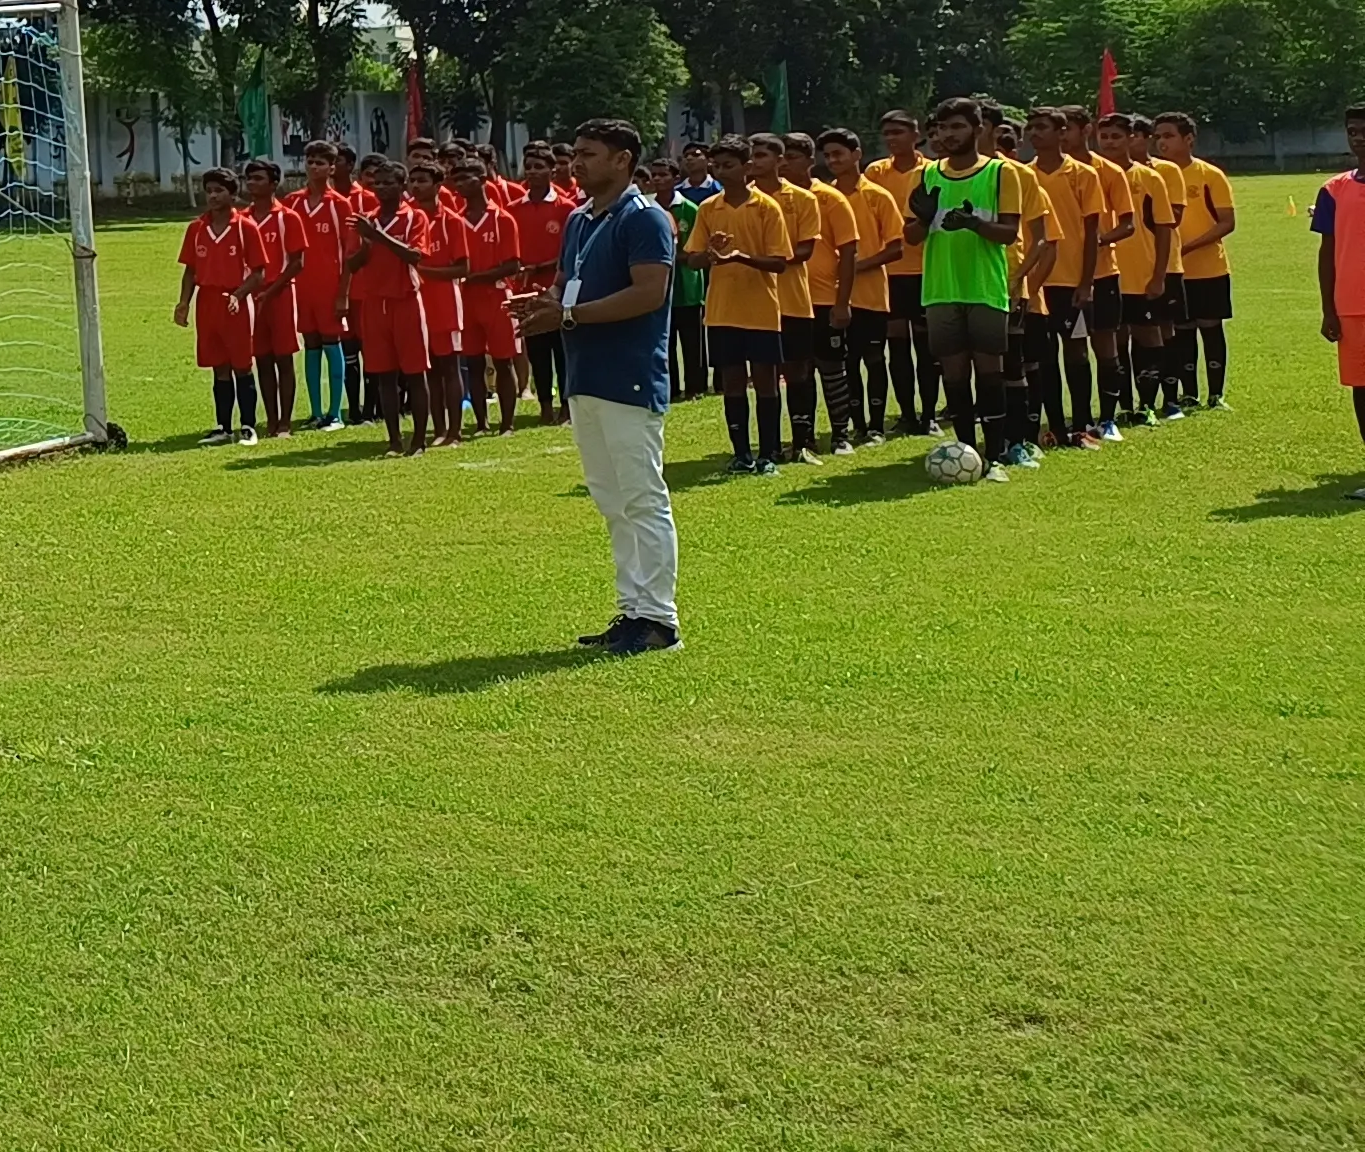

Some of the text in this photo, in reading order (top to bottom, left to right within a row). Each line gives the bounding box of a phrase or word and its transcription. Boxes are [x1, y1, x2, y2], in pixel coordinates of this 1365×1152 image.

[315, 223, 330, 234] 18
[264, 232, 277, 243] 17
[482, 232, 495, 243] 12
[228, 245, 237, 256] 3
